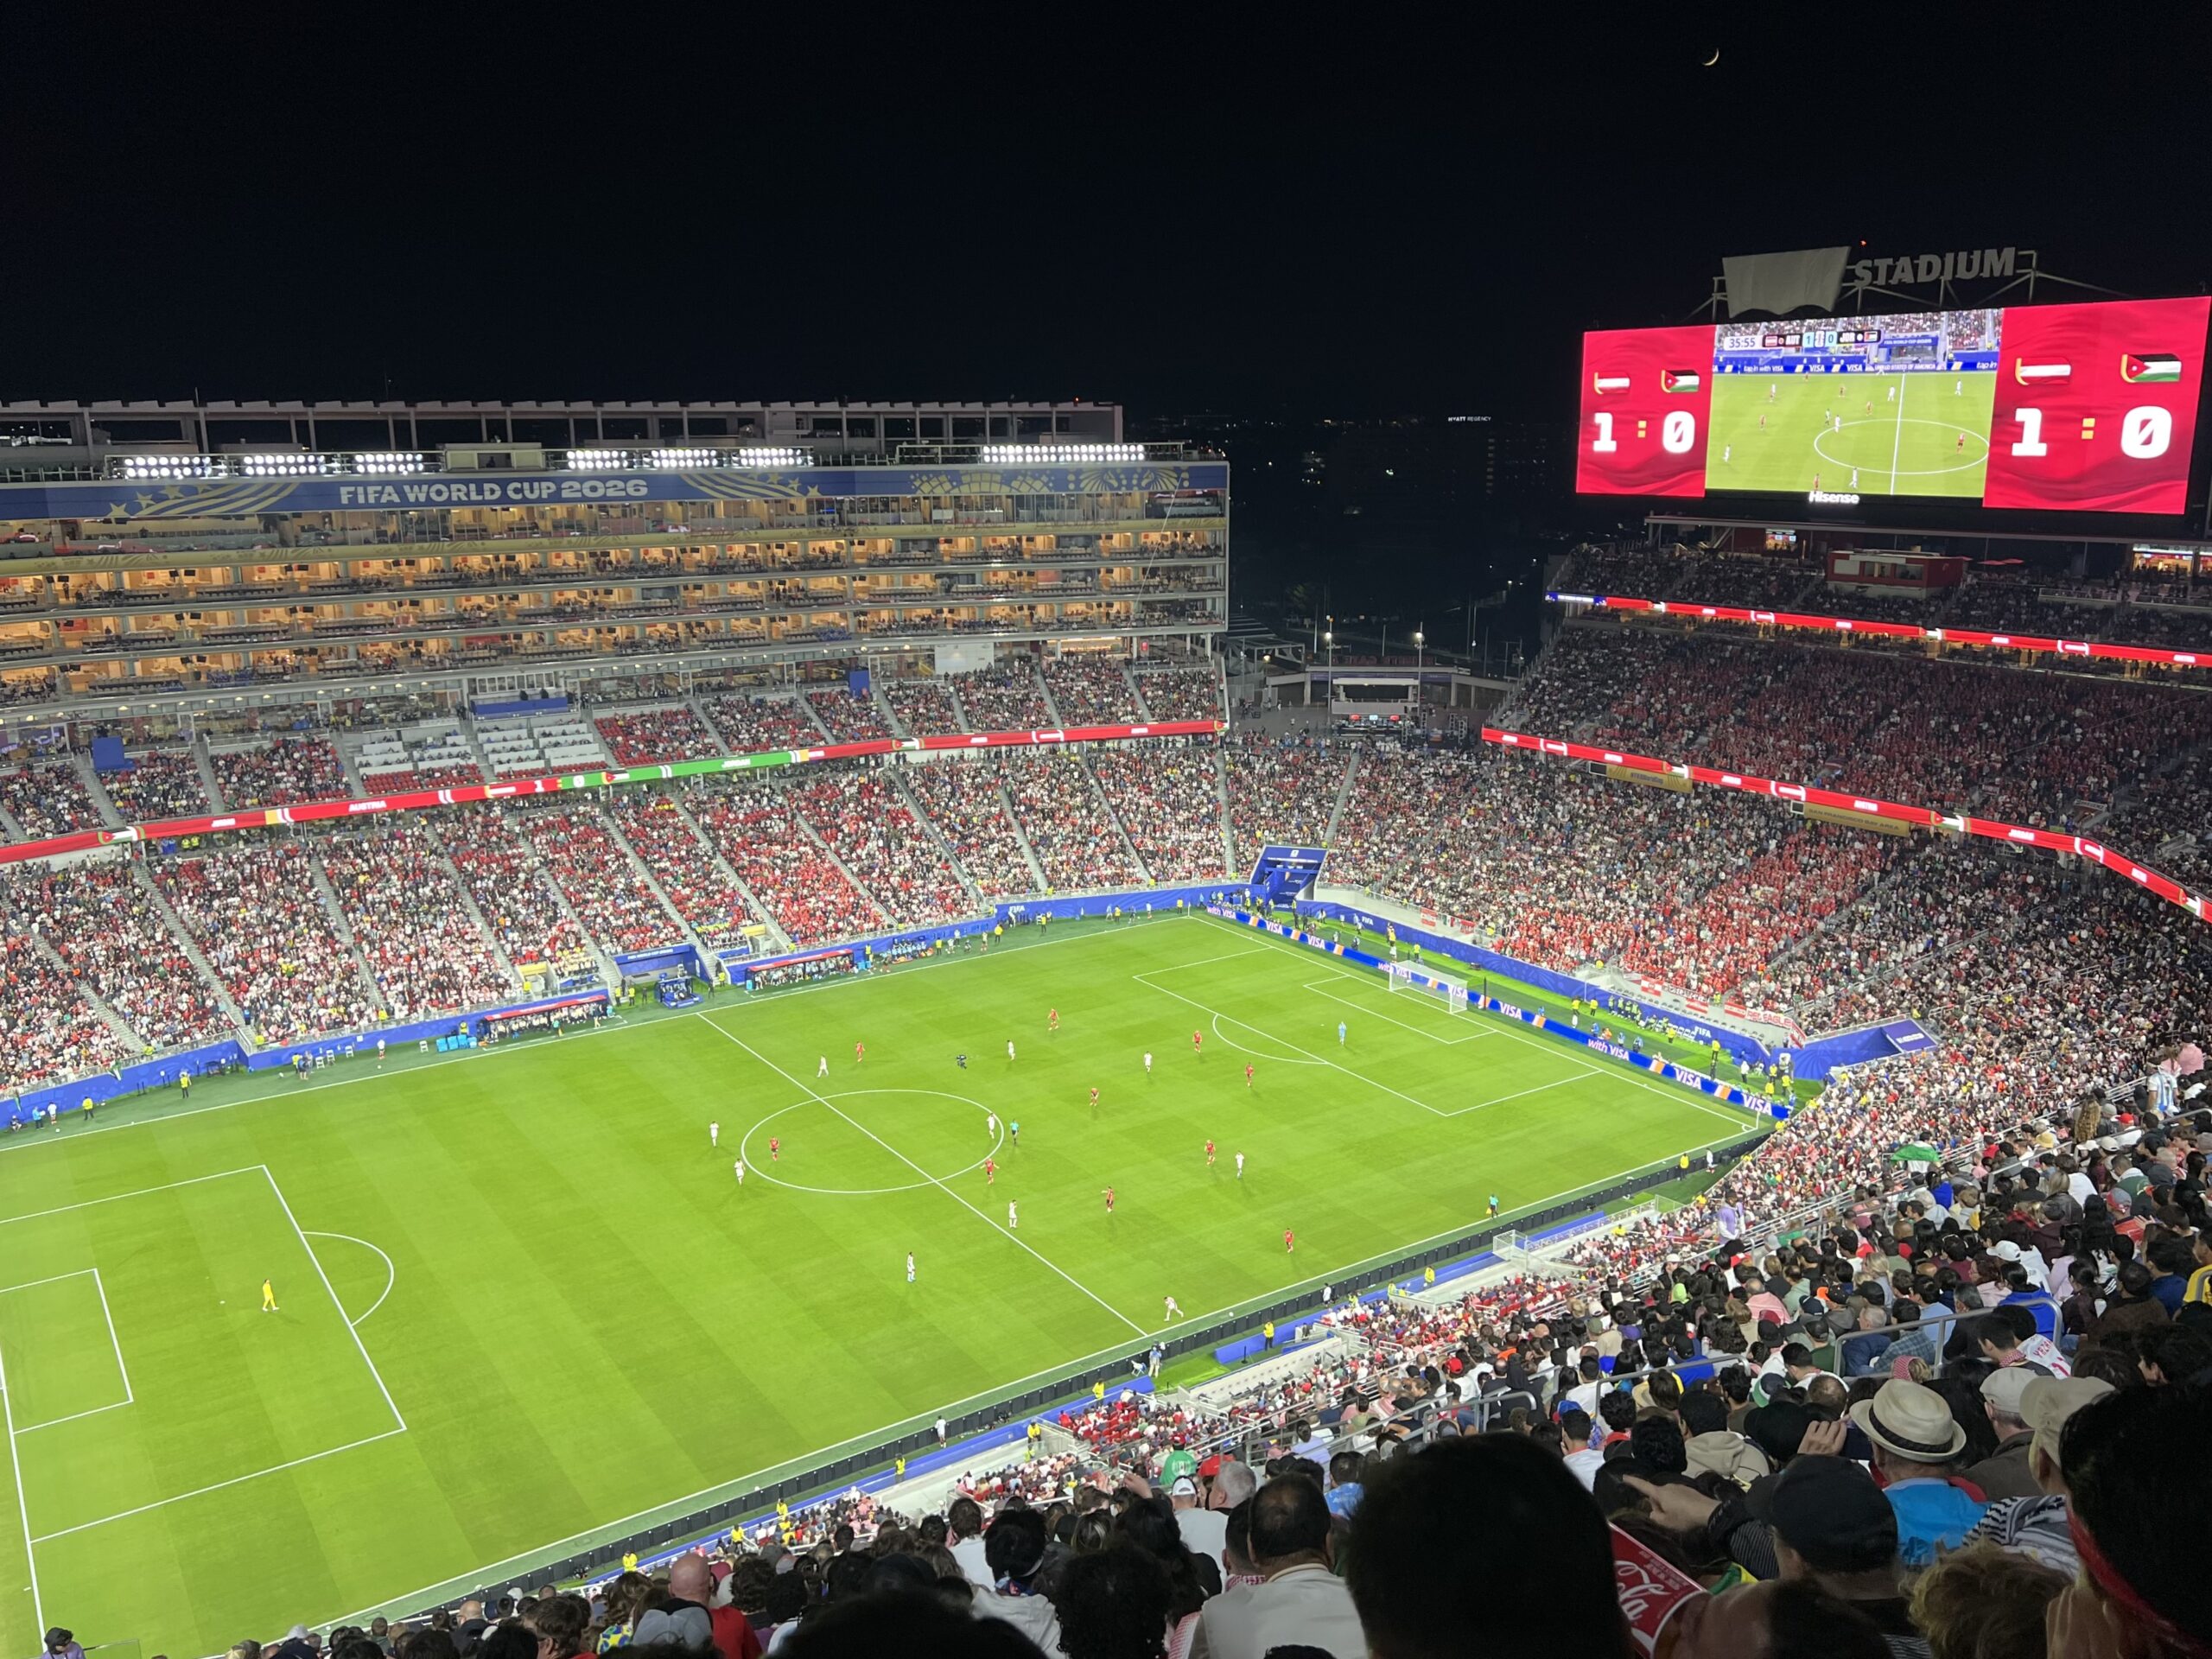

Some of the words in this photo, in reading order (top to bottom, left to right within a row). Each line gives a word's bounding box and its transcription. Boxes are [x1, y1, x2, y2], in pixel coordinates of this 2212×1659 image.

[1854, 247, 2015, 288] STADIUM
[1729, 337, 1756, 348] 35:55
[1786, 335, 1801, 345] AUT
[1807, 336, 1811, 345] 1
[1840, 333, 1855, 342] JOR
[1592, 412, 1617, 452] 1
[1662, 410, 1695, 453] 0
[2012, 408, 2047, 457] 1
[2121, 405, 2172, 459] 0
[340, 484, 402, 505] FIFA
[403, 482, 502, 503] WORLD
[506, 481, 558, 500] CUP
[561, 480, 648, 499] 2026
[1808, 490, 1860, 504] Hisense
[534, 780, 545, 792] 1
[348, 800, 387, 812] AUSTRIA
[1808, 807, 1823, 816] SAN
[1824, 810, 1864, 824] FRANCISCO
[1865, 819, 1878, 828] BAY
[1879, 822, 1899, 831] AREA
[1008, 905, 1026, 913] FIFA
[1207, 906, 1221, 917] with
[1222, 907, 1236, 920] VISA
[1266, 921, 1283, 936] VISA
[1361, 915, 1374, 926] FIFA
[1307, 936, 1325, 950] VISA
[1447, 984, 1468, 1001] VISA
[1498, 1001, 1523, 1020] VISA
[1694, 1026, 1712, 1038] FIFA
[1588, 1038, 1608, 1052] with
[1609, 1044, 1630, 1062] VISA
[1674, 1067, 1702, 1090] VISA
[1741, 1093, 1773, 1116] VISA
